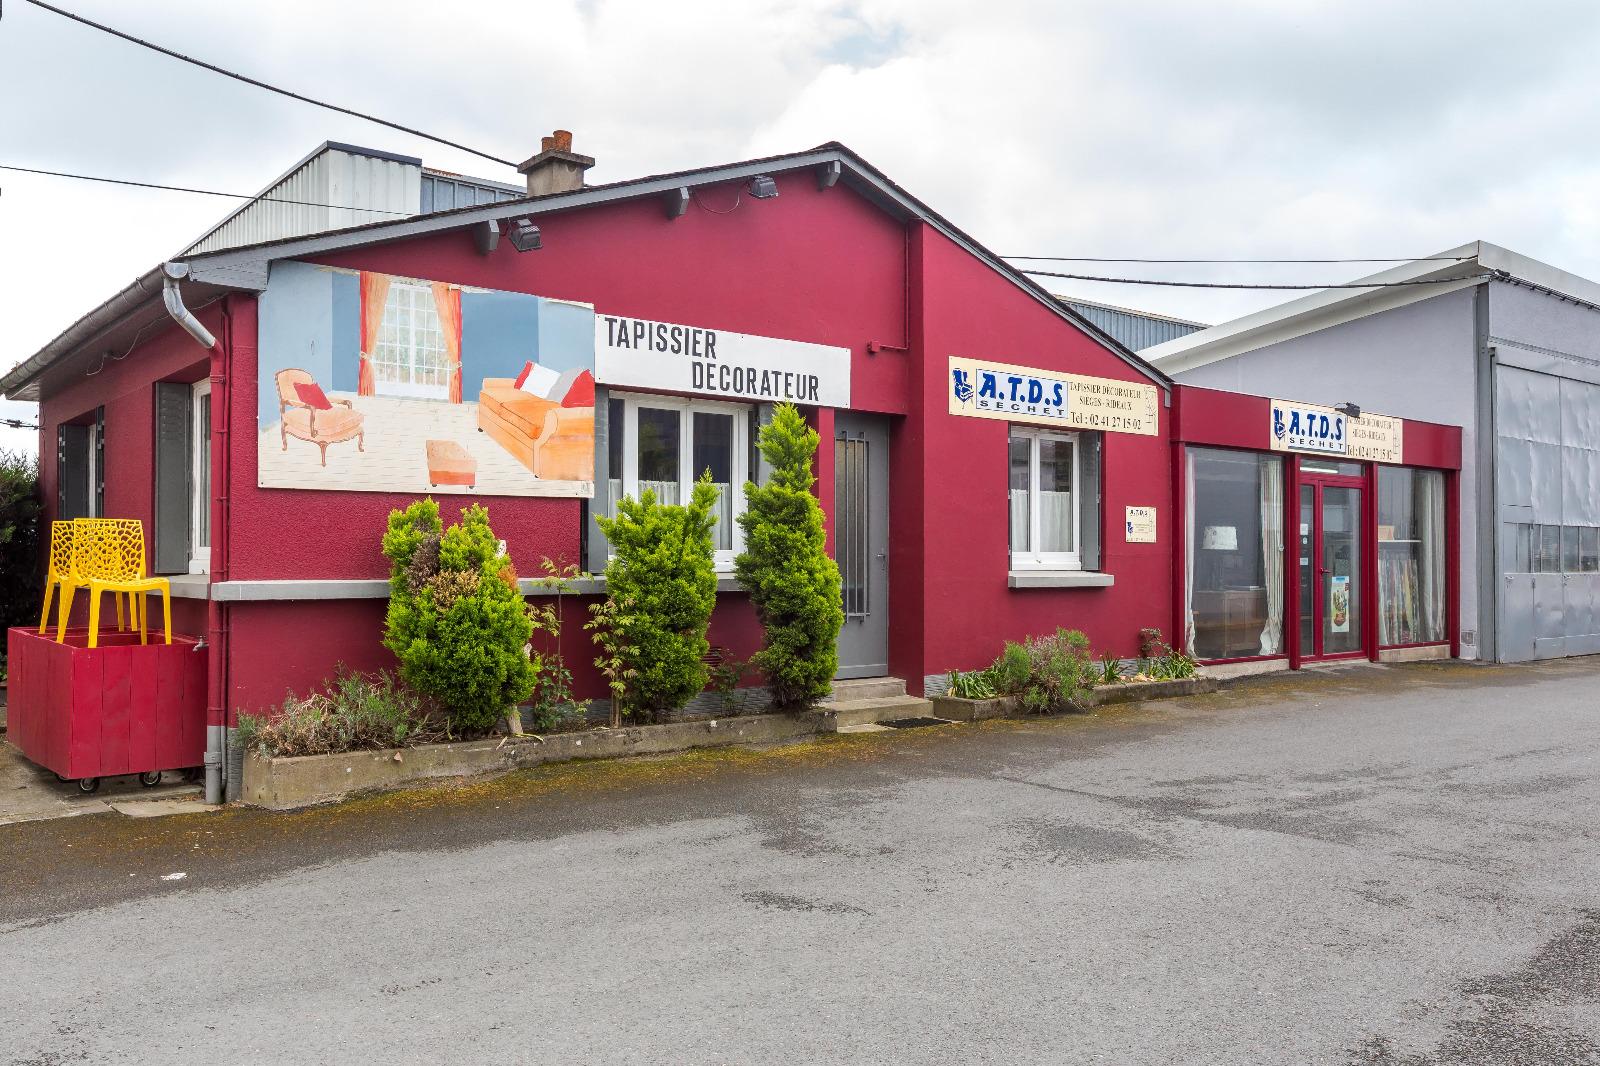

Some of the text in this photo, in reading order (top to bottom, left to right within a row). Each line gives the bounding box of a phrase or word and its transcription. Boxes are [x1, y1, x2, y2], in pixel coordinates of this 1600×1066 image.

[605, 317, 717, 359] TAPISSIER
[692, 361, 819, 401] DECORATEUR
[979, 373, 1062, 407] A.T.D.S
[1069, 381, 1101, 394] TAPISSIER
[980, 400, 1064, 416] SECHET
[1101, 416, 1109, 427] 41
[1112, 416, 1121, 428] 27
[1289, 411, 1343, 441] A.T.D.S
[1289, 437, 1344, 449] SECHET
